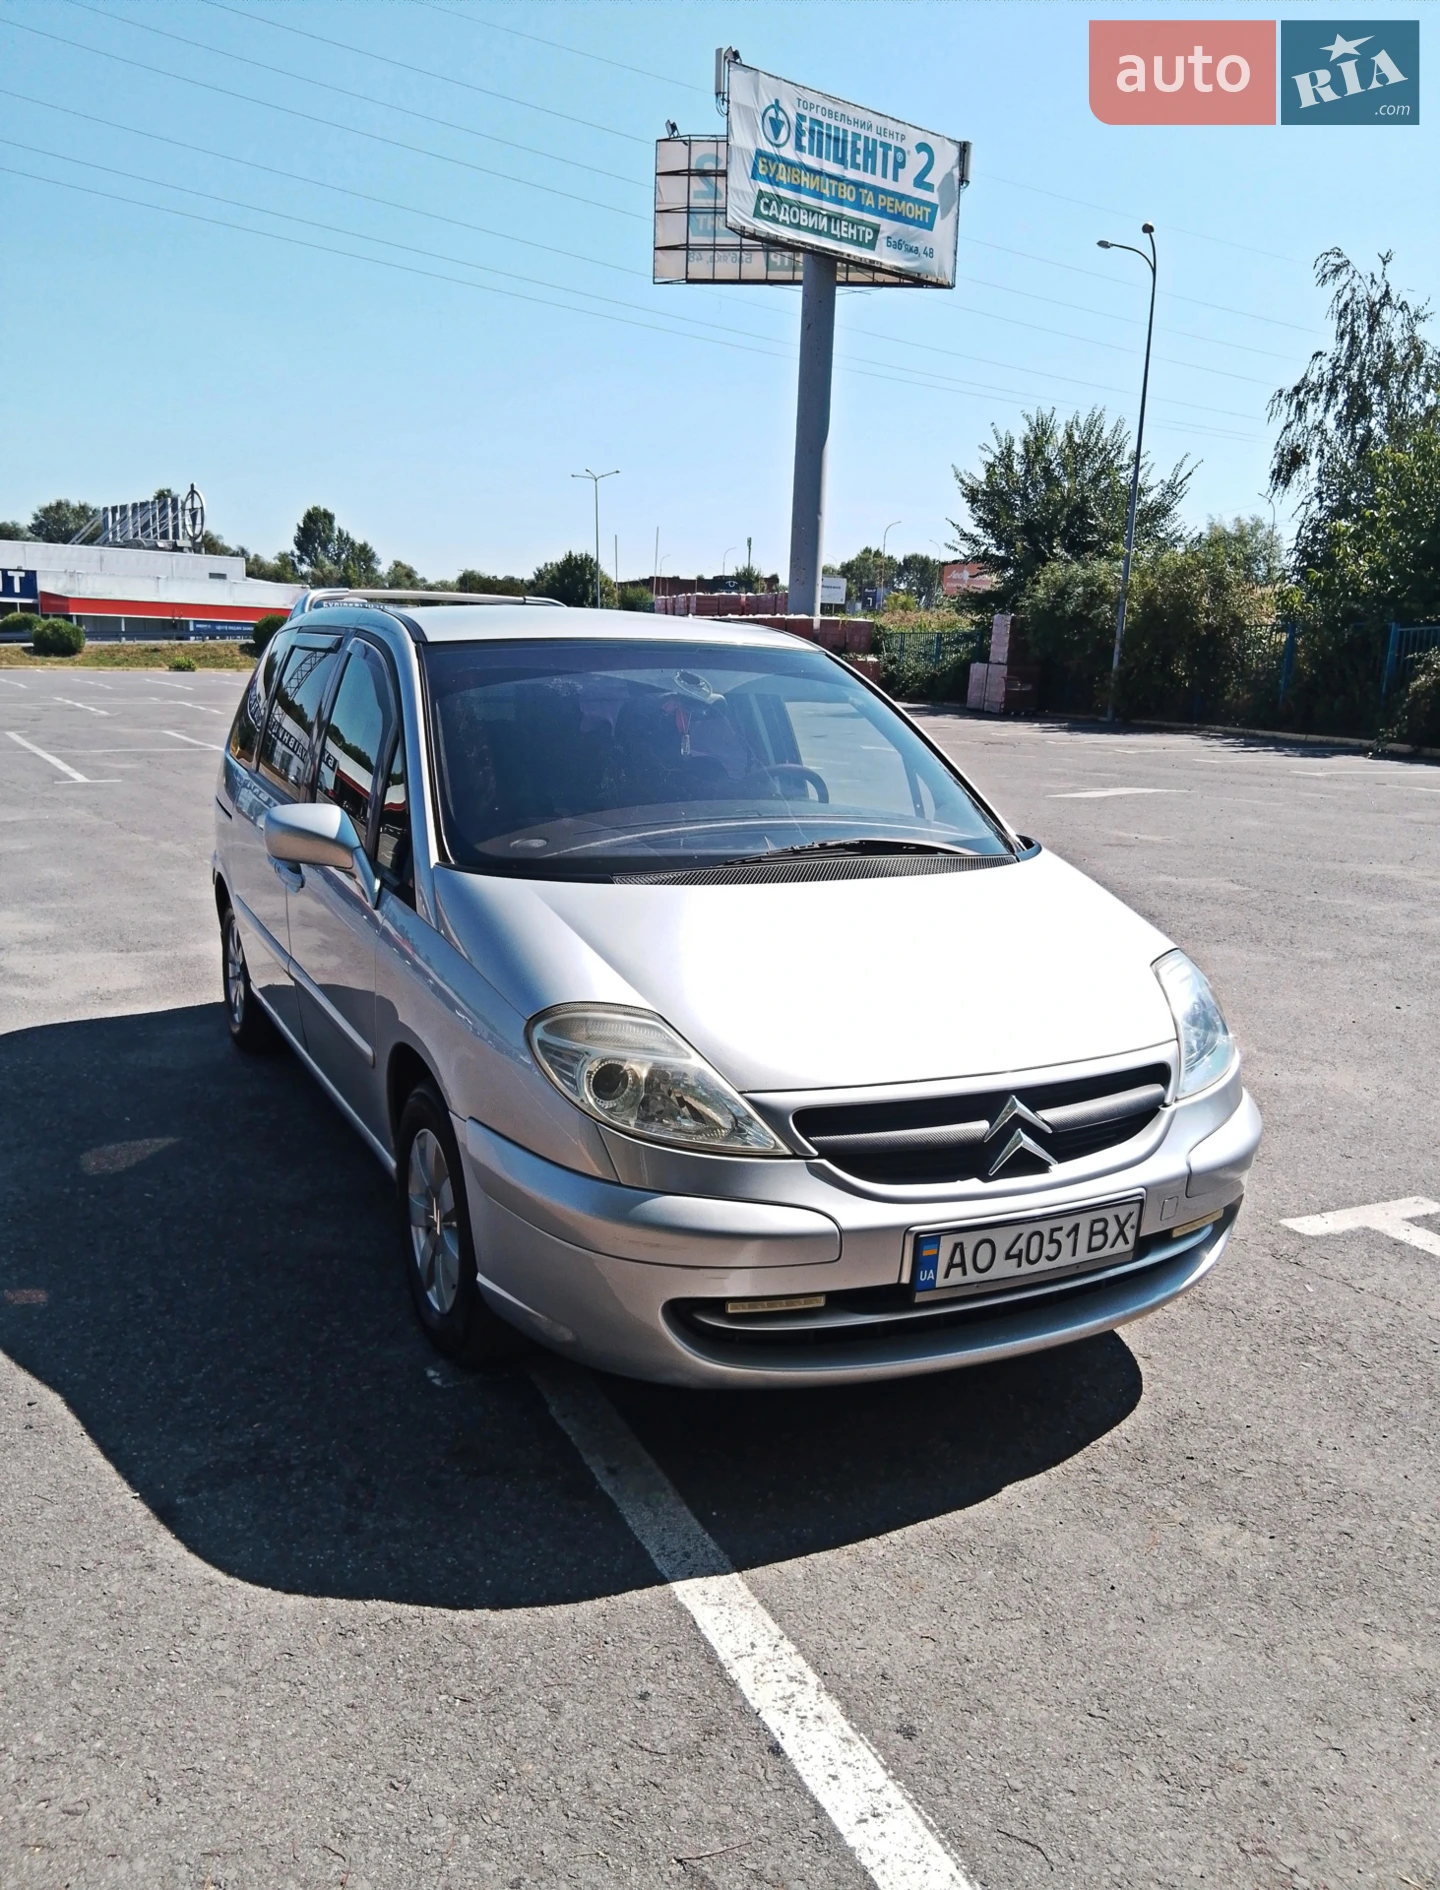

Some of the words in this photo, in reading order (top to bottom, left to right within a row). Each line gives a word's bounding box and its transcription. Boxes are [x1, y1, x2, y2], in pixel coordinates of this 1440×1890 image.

[796, 98, 873, 132] ТОРГОВЕЛЬНИЙ
[876, 125, 907, 143] ЦЕНТР
[795, 112, 907, 183] ЕПІЦЕНТР
[912, 141, 936, 193] 2
[758, 156, 856, 202] БУДІВНИЦТВО
[859, 188, 875, 208] ТА
[878, 194, 931, 223] РЕМОНТ
[760, 197, 828, 233] САДОВИЙ
[831, 220, 874, 244] ЦЕНТР
[922, 245, 934, 259] 48
[944, 1238, 996, 1280] AO
[1004, 1222, 1081, 1268] 4051
[1086, 1211, 1135, 1254] BX
[919, 1269, 935, 1282] UA
